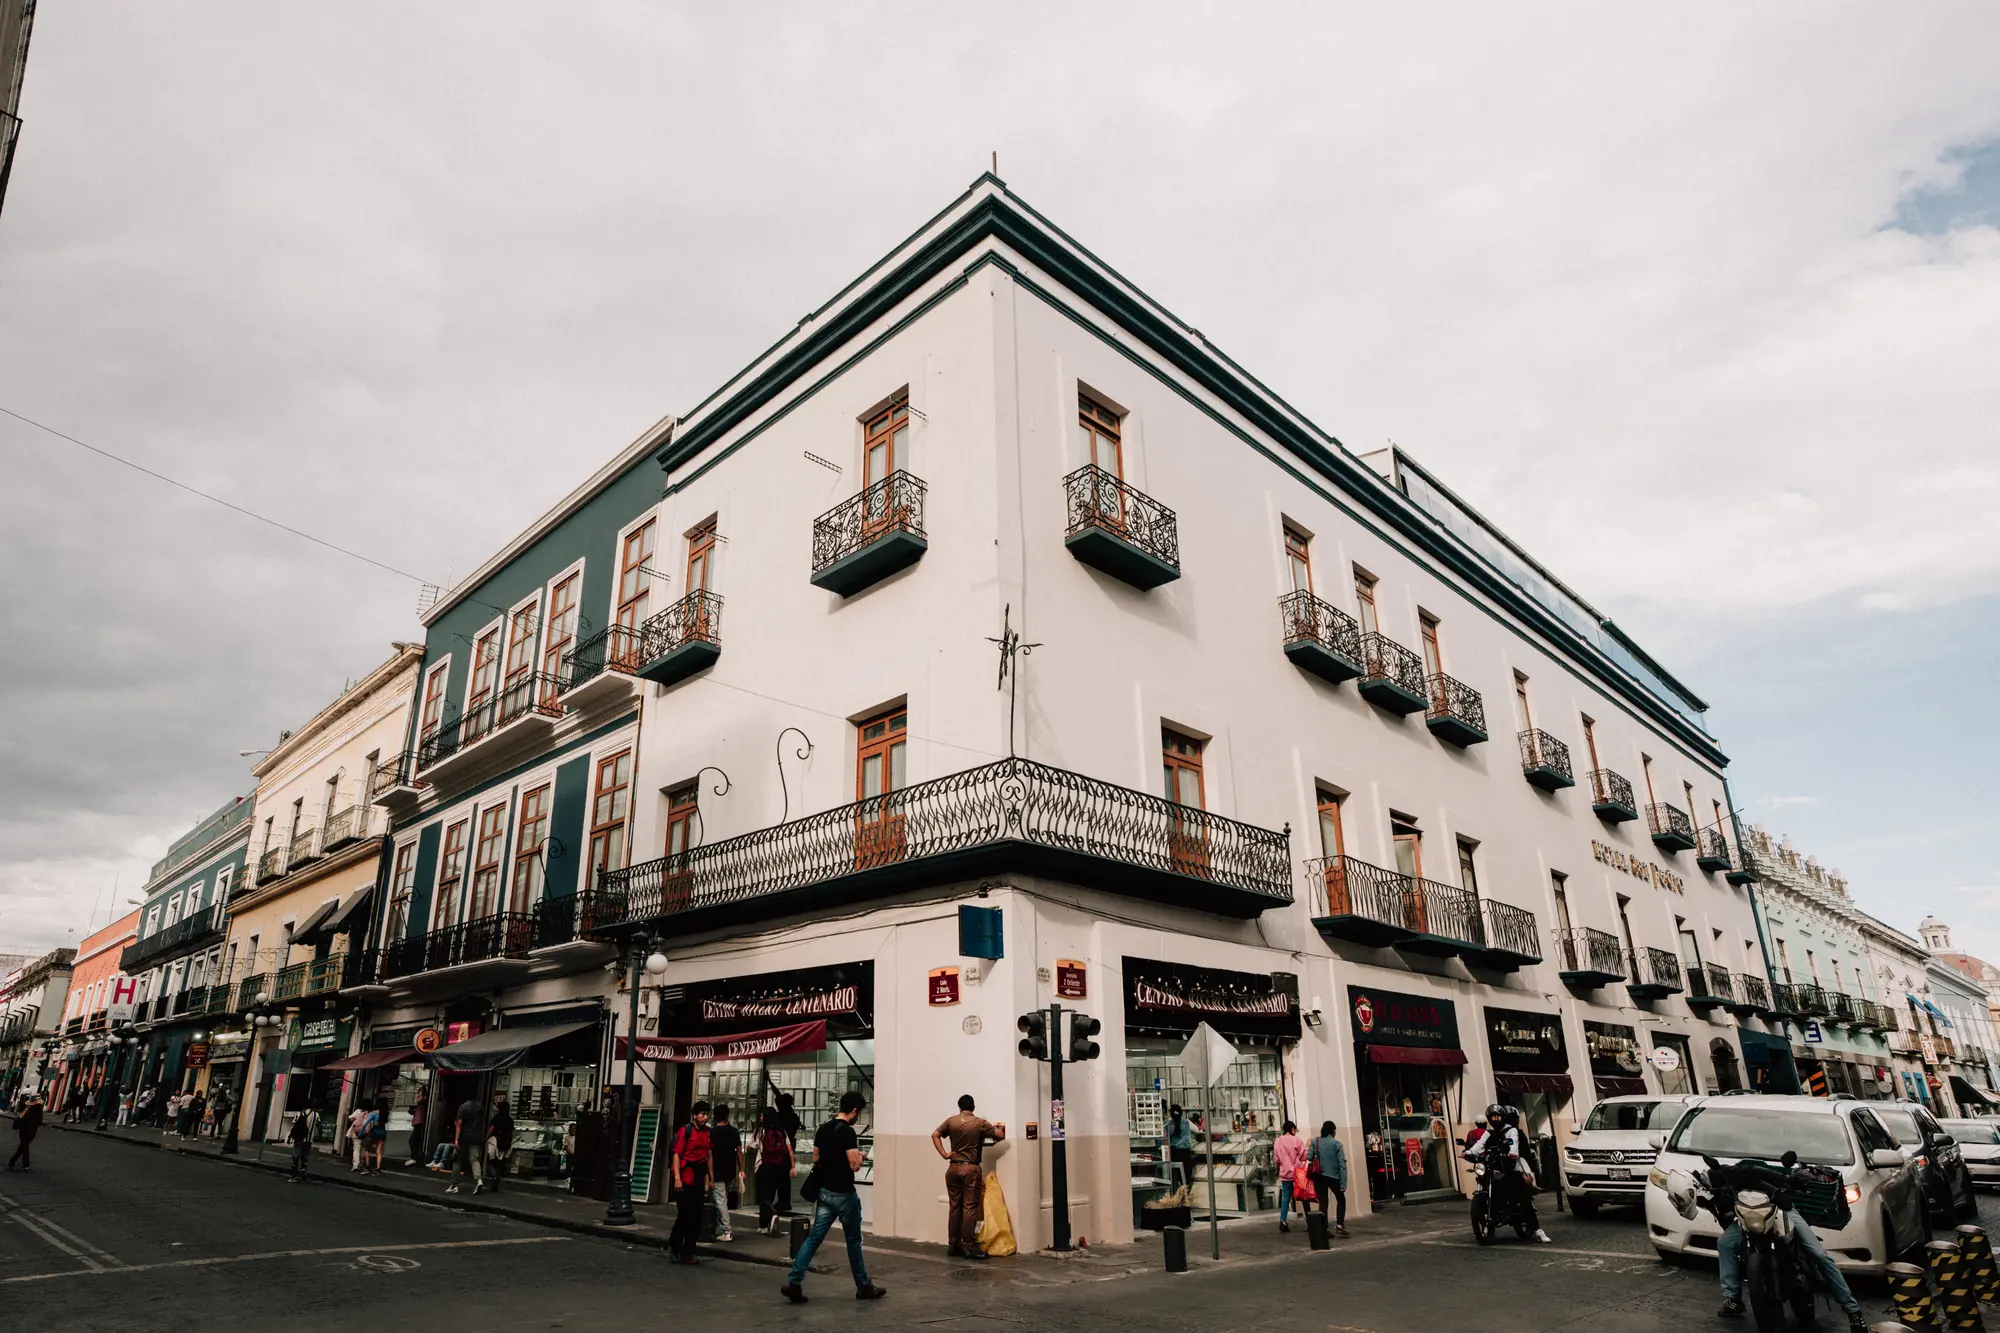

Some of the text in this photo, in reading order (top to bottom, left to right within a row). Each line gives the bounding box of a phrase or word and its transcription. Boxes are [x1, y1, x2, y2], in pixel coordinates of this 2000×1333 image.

[113, 977, 137, 1004] H
[1067, 979, 1081, 987] Oriente
[703, 1000, 737, 1019] CENTRO
[785, 987, 855, 1016] CENTENARIO
[1137, 982, 1183, 1007] CENTRO
[1230, 992, 1289, 1013] CENTENARIO
[643, 1036, 782, 1060] CENTRO JOYERO CENTENARIO
